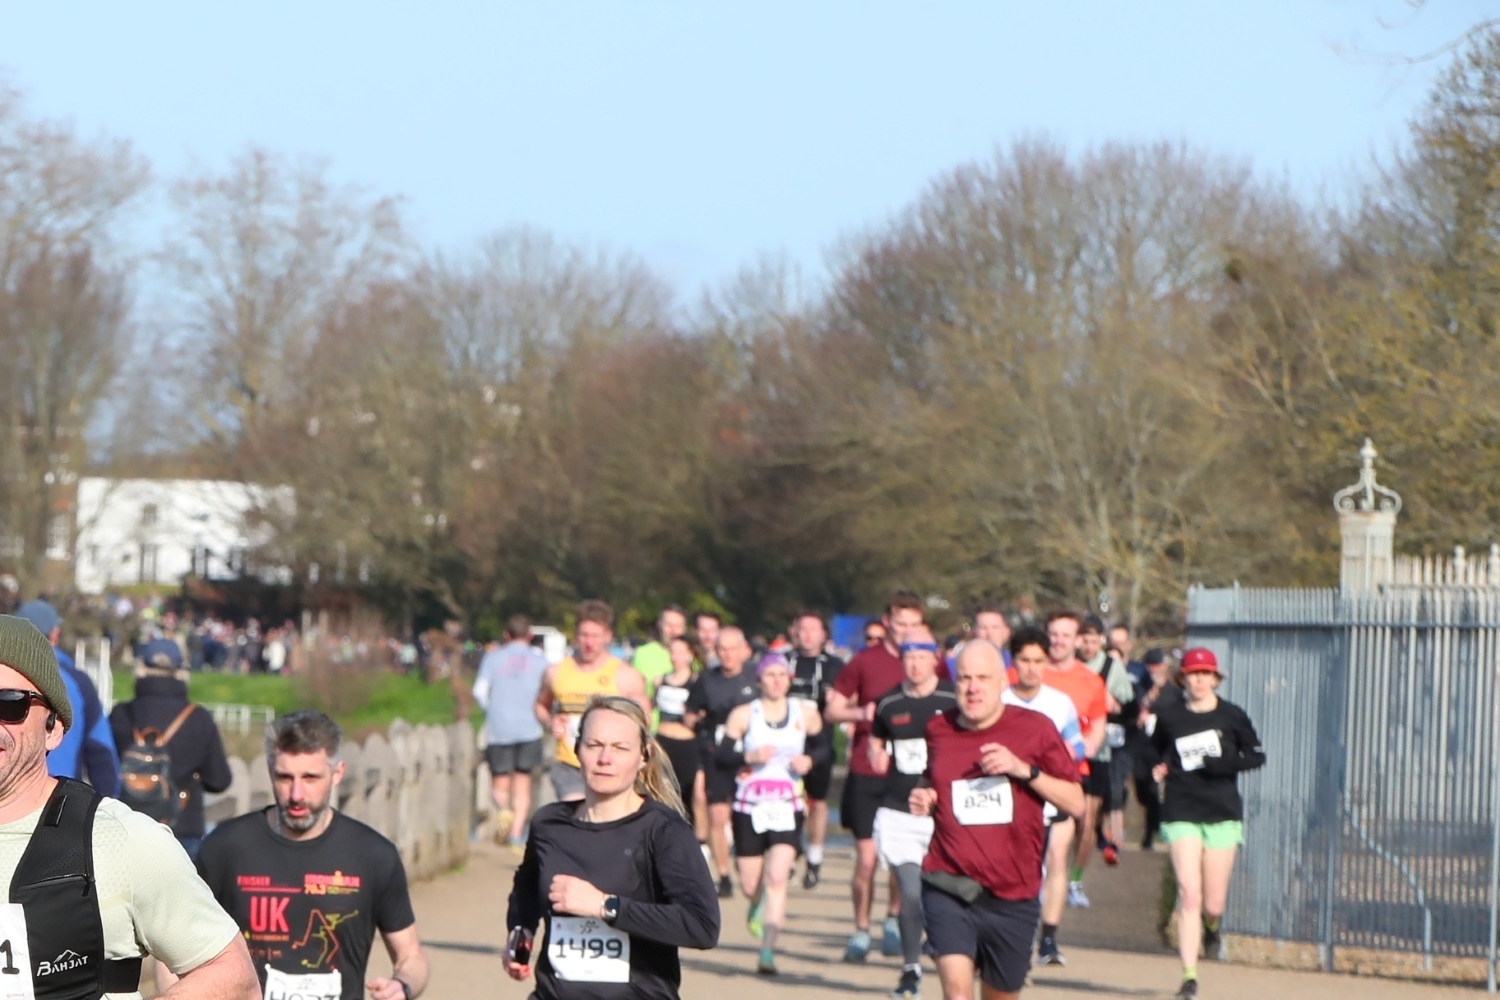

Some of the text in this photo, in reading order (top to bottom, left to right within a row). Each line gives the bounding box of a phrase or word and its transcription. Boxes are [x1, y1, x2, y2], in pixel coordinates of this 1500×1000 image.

[250, 896, 291, 933] UK
[555, 938, 623, 959] 1499
[36, 955, 88, 976] BAHJAT
